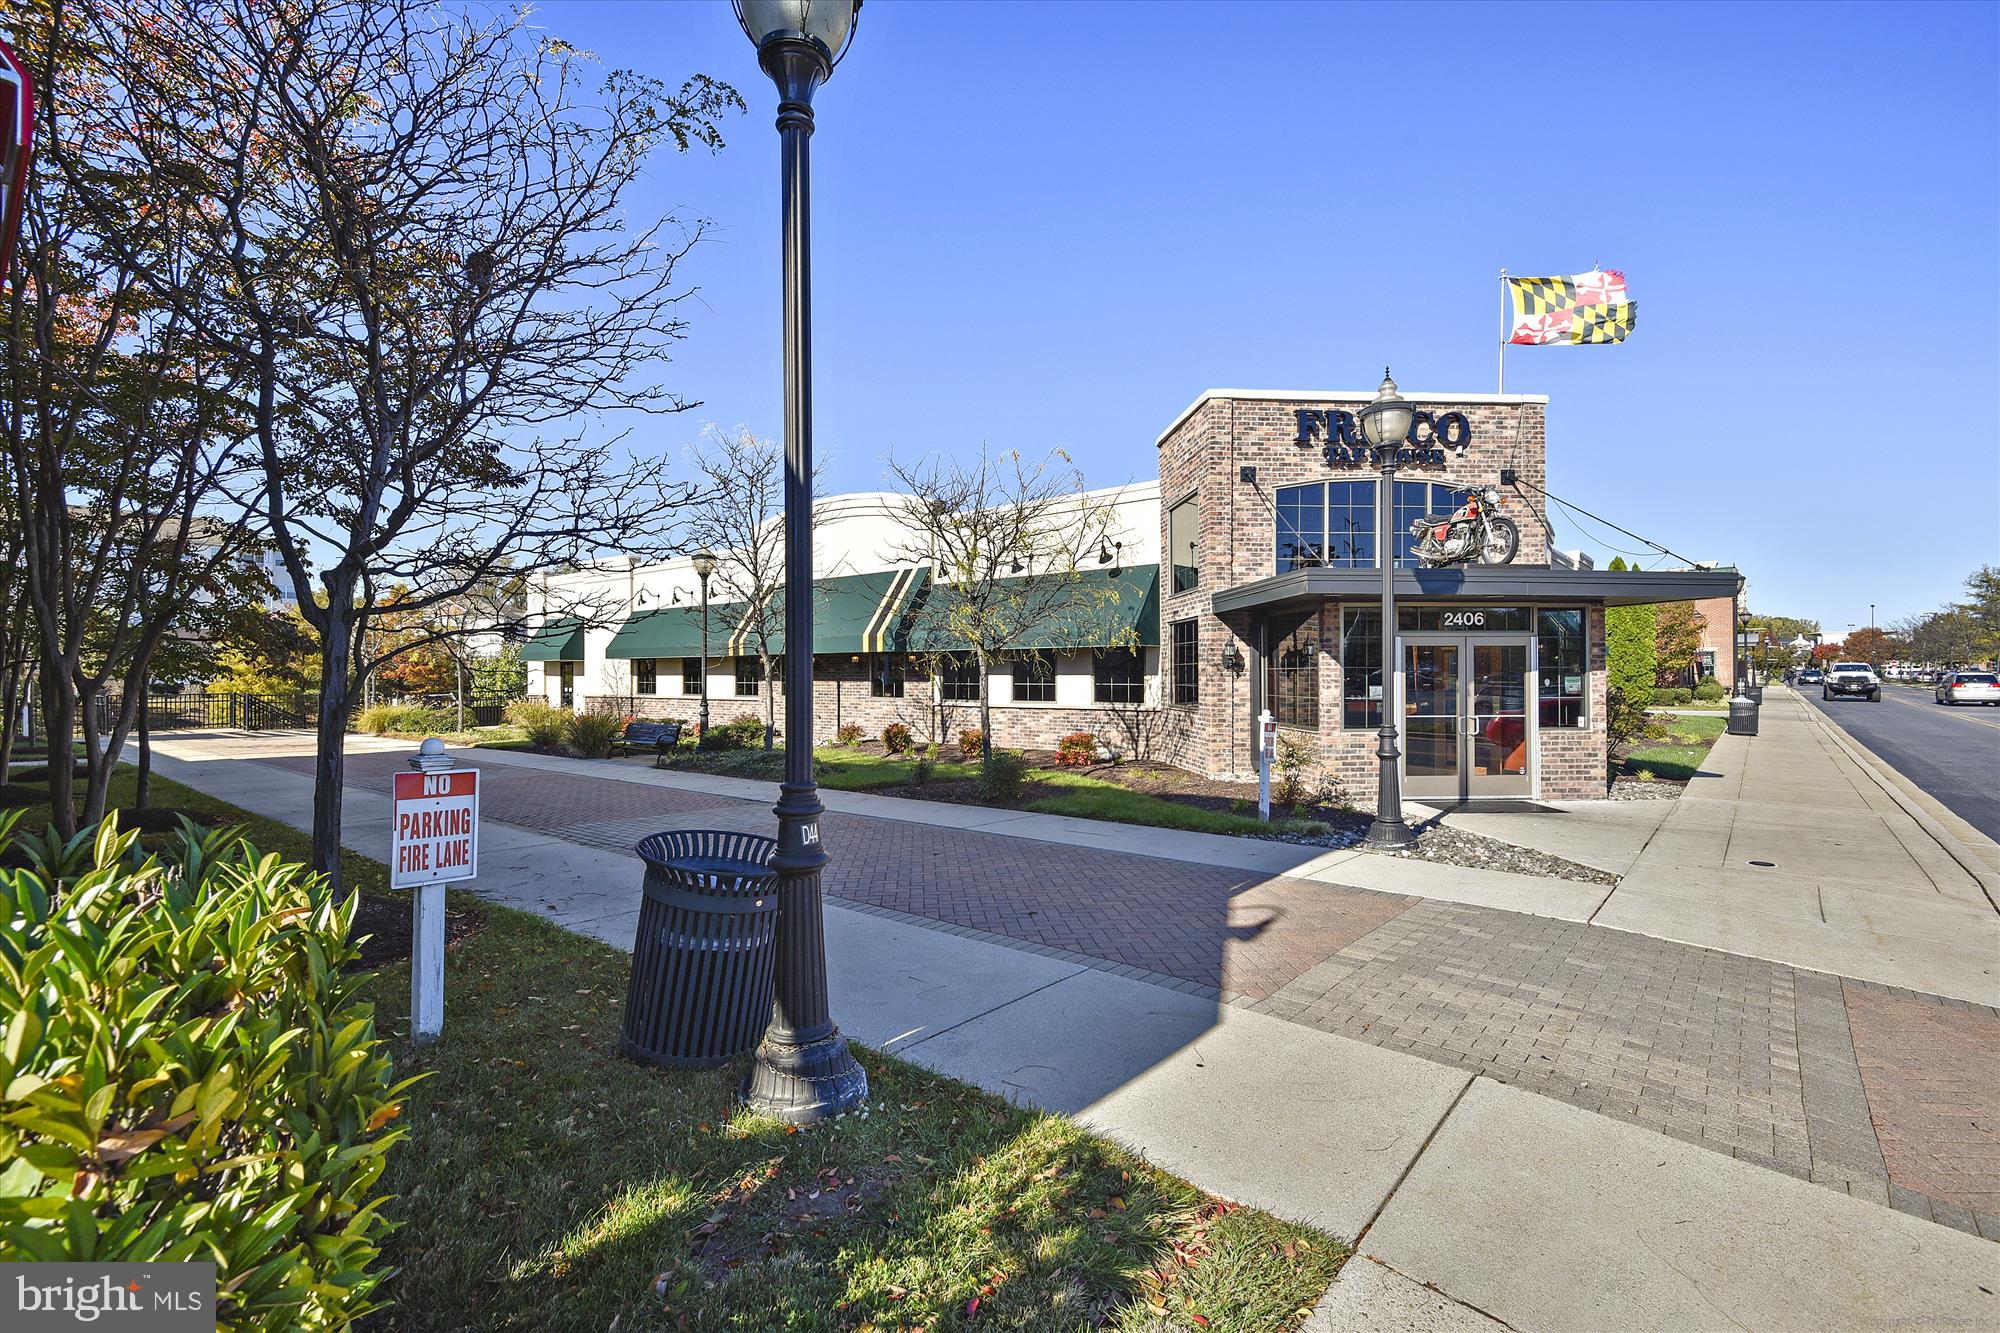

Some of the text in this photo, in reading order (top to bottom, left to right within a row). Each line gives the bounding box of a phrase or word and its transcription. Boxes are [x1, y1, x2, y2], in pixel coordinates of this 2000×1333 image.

[1295, 409, 1470, 449] FRCO
[1324, 448, 1367, 464] TAP
[1444, 612, 1485, 626] 2406
[423, 774, 451, 796] NO
[400, 807, 471, 841] PARKING
[802, 823, 819, 845] D44
[399, 839, 469, 873] FIRE LANE
